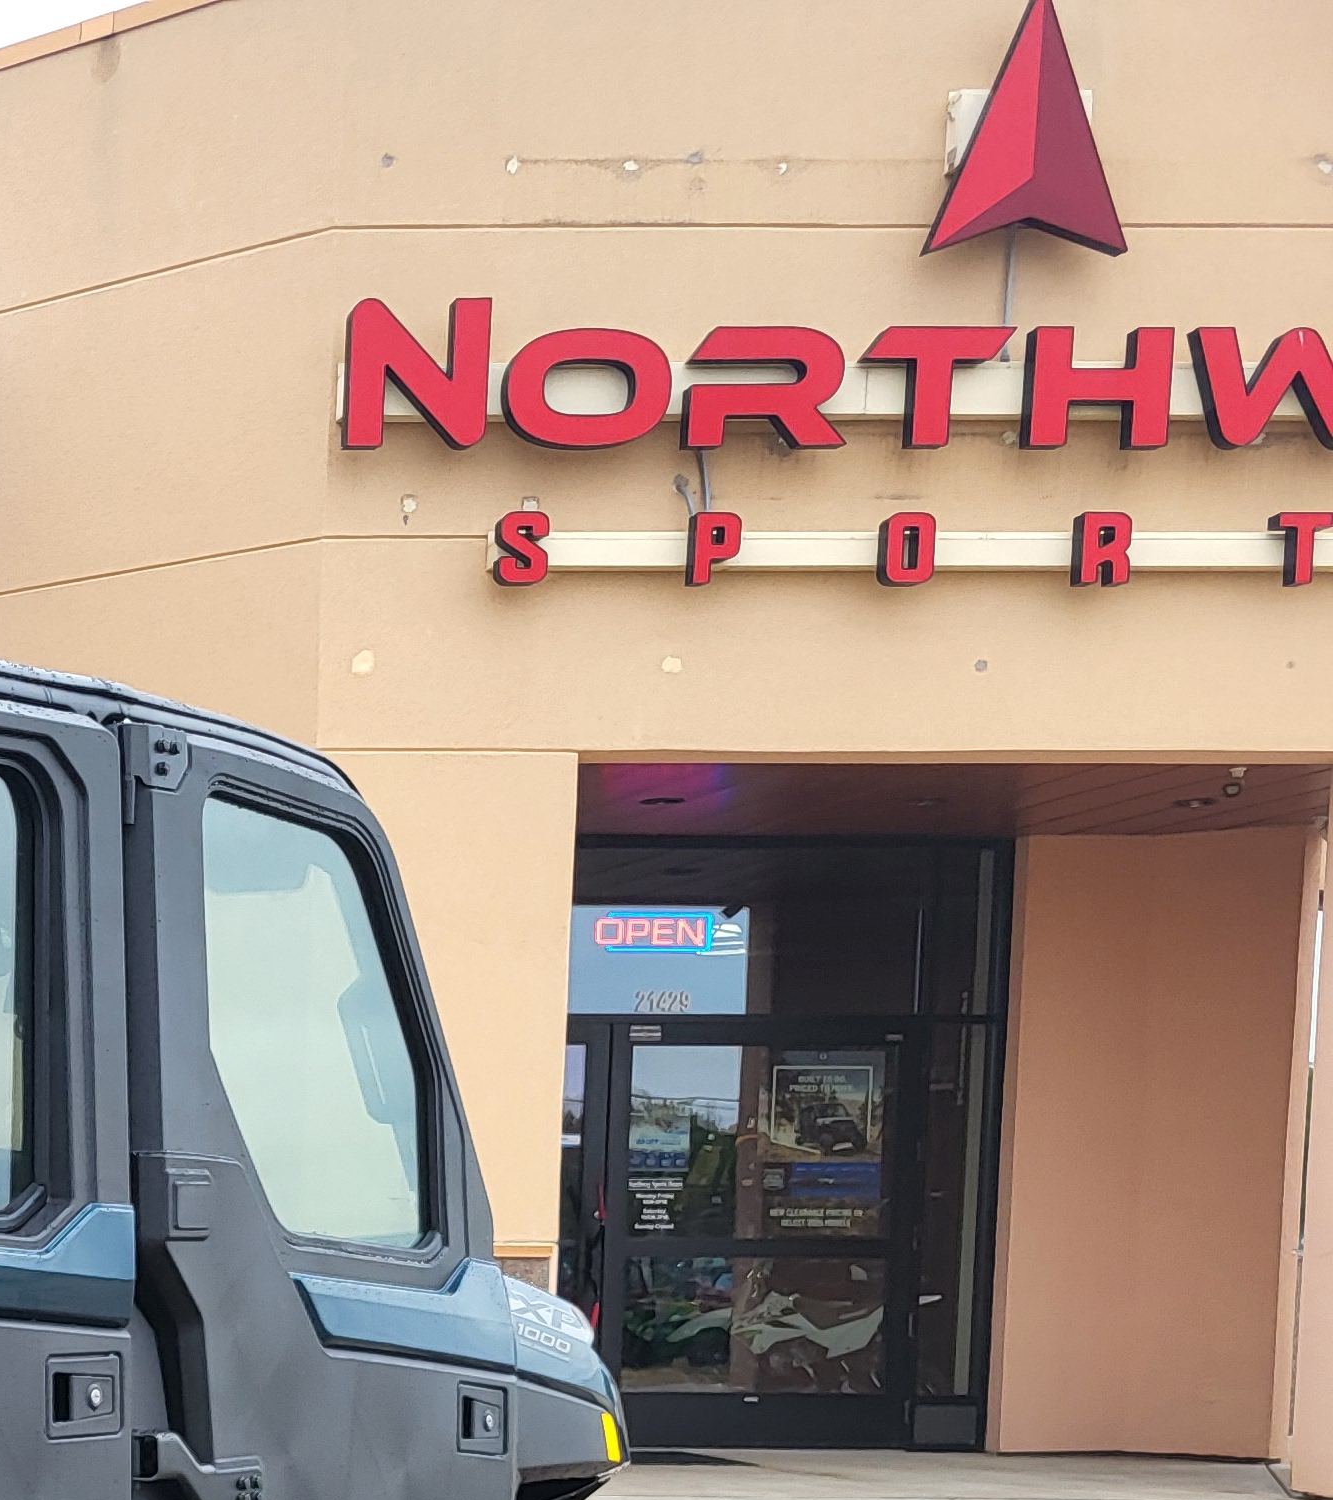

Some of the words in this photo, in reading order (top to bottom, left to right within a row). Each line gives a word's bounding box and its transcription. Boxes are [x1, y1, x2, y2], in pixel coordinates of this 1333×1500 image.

[594, 917, 706, 946] OPEN
[634, 990, 692, 1012] 21429
[510, 1291, 584, 1330] XP
[517, 1323, 572, 1354] 1000
